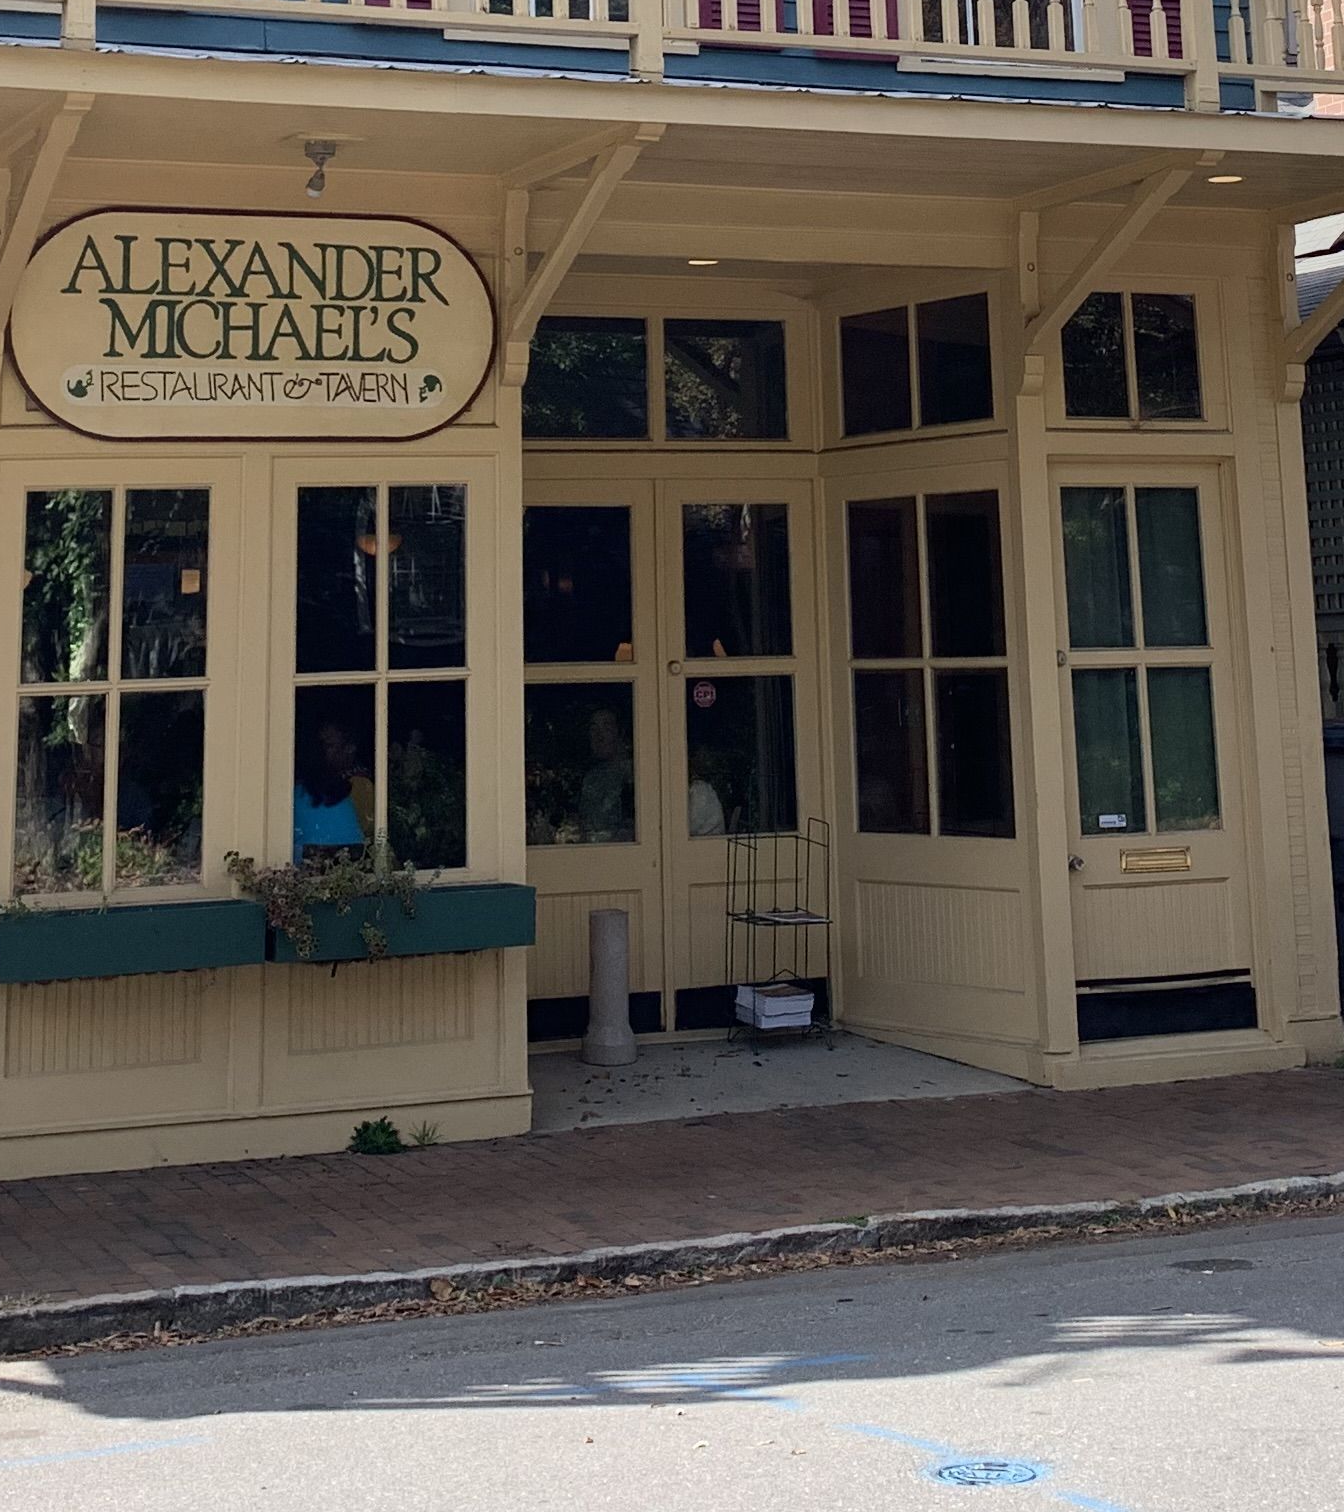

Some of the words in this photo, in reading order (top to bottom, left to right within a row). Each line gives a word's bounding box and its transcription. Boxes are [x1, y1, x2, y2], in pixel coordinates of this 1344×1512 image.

[60, 234, 450, 306] ALEXANDER
[98, 297, 420, 364] MICHAEL'S
[99, 371, 283, 403] RESTAURANT
[283, 373, 323, 402] &
[321, 372, 410, 405] TAVERN
